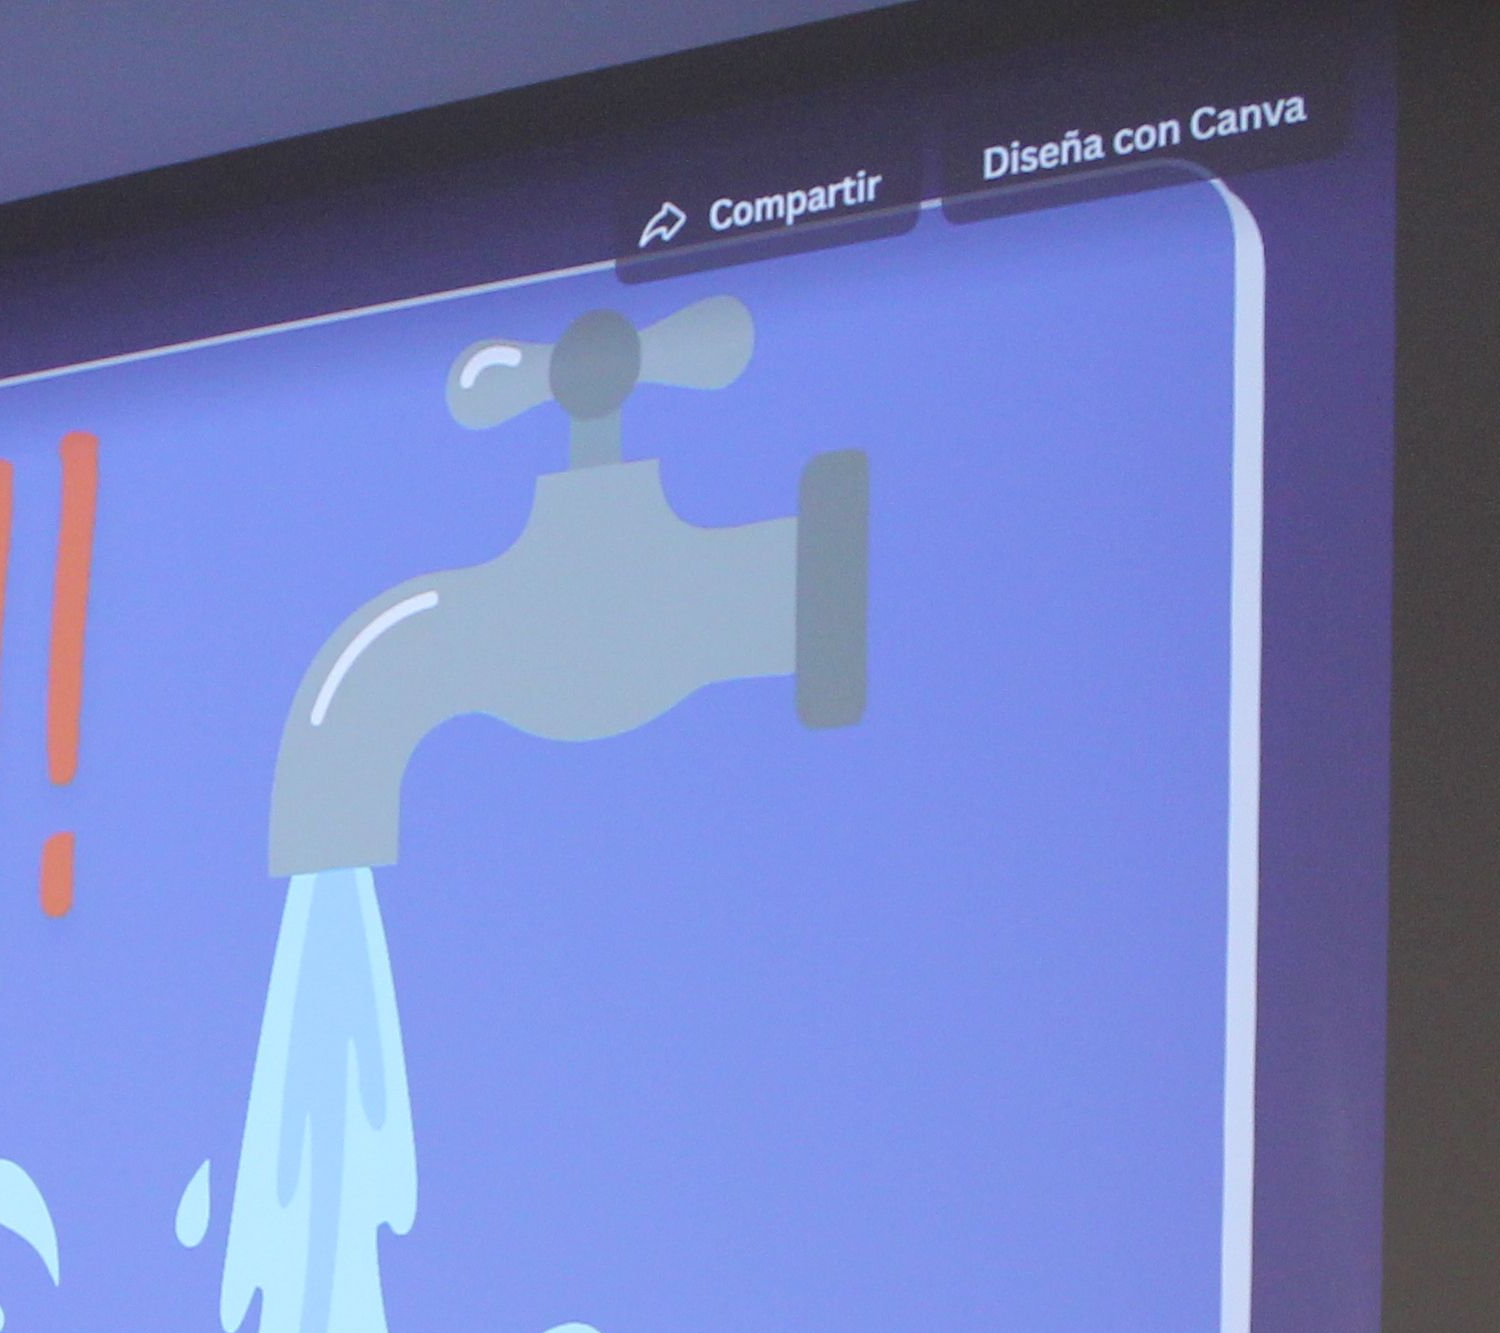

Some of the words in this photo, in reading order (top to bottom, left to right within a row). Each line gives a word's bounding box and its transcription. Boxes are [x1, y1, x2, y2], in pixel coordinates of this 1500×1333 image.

[983, 130, 1104, 181] Diseña
[1114, 112, 1181, 157] con
[1190, 94, 1308, 143] Canva
[709, 170, 883, 232] Compartir
